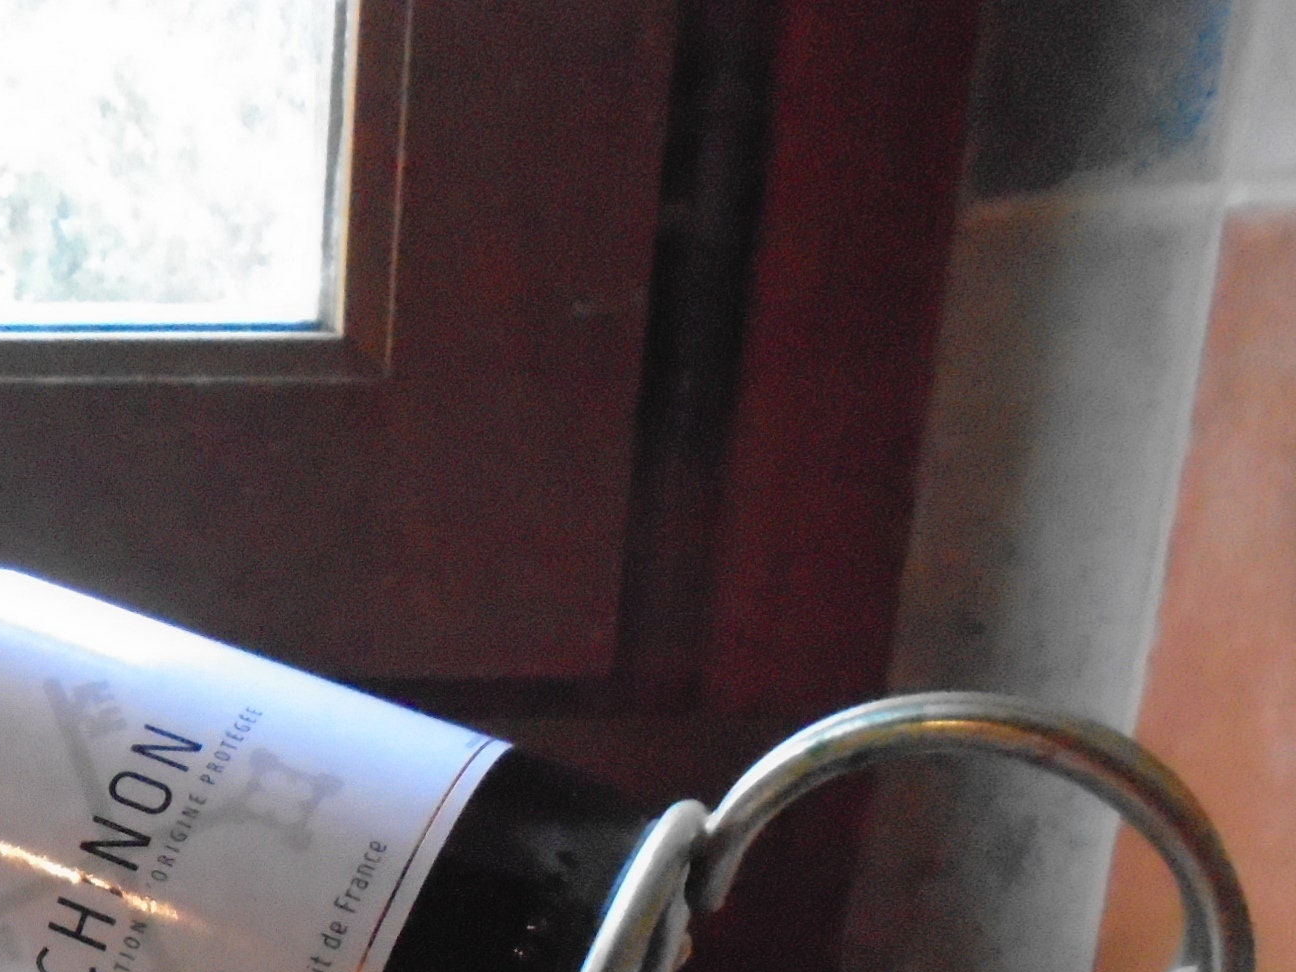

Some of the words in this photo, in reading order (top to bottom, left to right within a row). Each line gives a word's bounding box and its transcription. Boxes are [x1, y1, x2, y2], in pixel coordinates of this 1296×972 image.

[134, 793, 208, 902] 'ORIGINE
[333, 839, 388, 914] France
[320, 919, 349, 951] de
